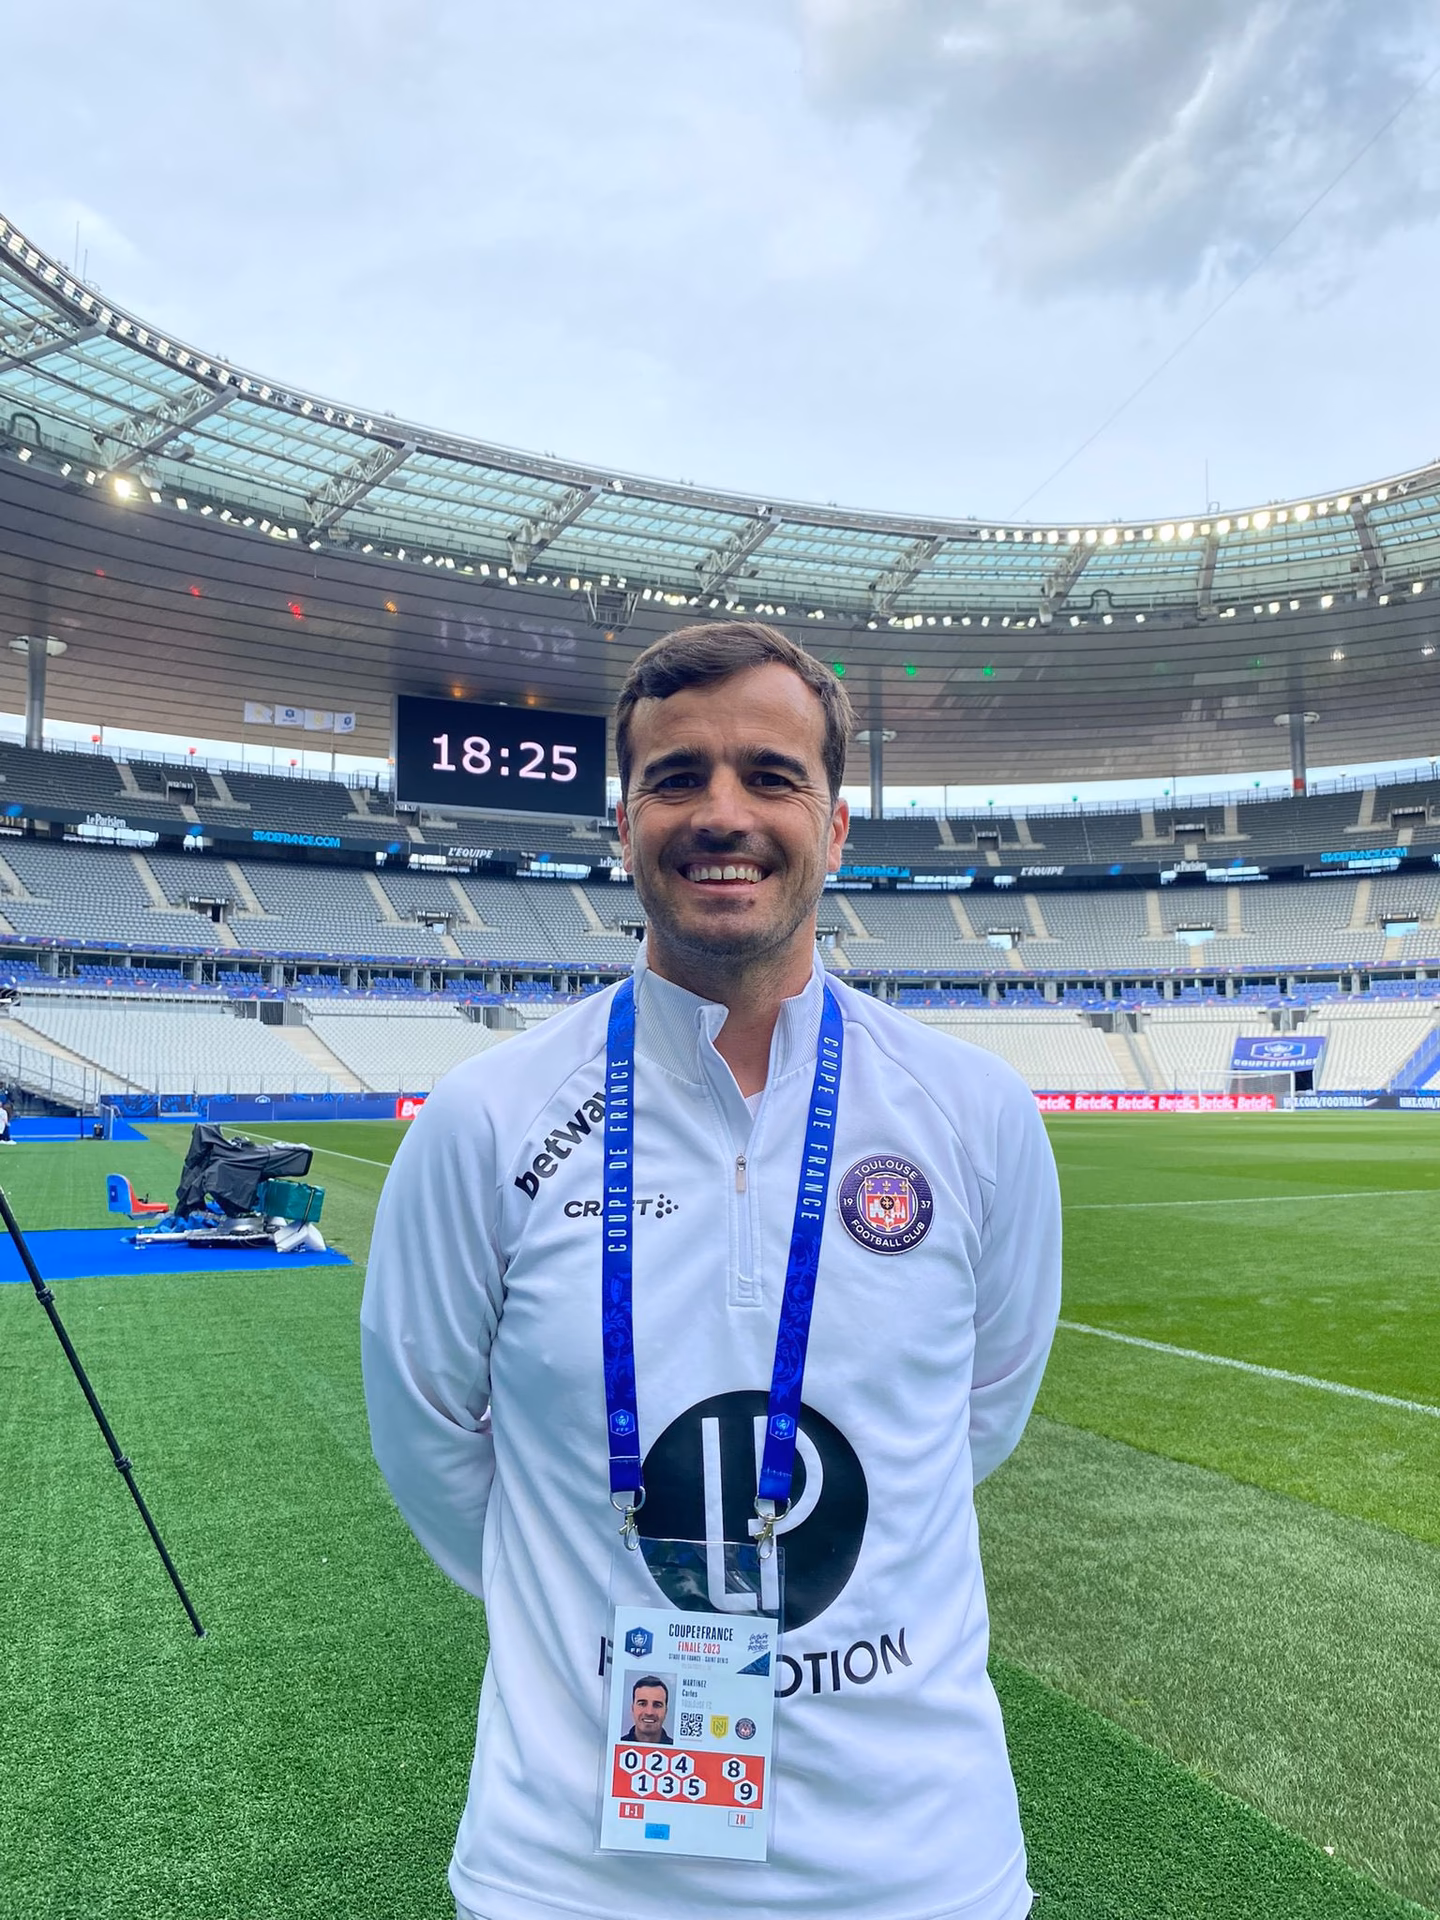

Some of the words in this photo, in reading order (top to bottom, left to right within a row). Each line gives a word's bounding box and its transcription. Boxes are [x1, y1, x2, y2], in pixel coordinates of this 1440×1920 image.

[432, 733, 577, 782] 18:25
[816, 1036, 839, 1095] COUPE
[609, 1058, 630, 1133] FRANCE
[812, 1107, 833, 1130] DE
[608, 1147, 628, 1170] DE
[854, 1159, 918, 1181] TOULOUSE
[800, 1142, 828, 1221] FRANCE
[563, 1199, 653, 1218] CRT
[843, 1197, 853, 1207] 19
[920, 1200, 931, 1209] 37
[607, 1185, 629, 1253] COUPE
[850, 1218, 901, 1248] FOOTBALL
[903, 1221, 926, 1245] CLUB
[677, 1641, 701, 1653] FINALE
[702, 1643, 721, 1655] 2023
[624, 1751, 638, 1769] 0
[650, 1754, 663, 1771] 2
[675, 1756, 688, 1773] 4
[727, 1760, 740, 1778] 8
[638, 1774, 648, 1792] 1
[662, 1776, 674, 1794] 3
[688, 1779, 700, 1796] 5
[739, 1782, 753, 1800] 9
